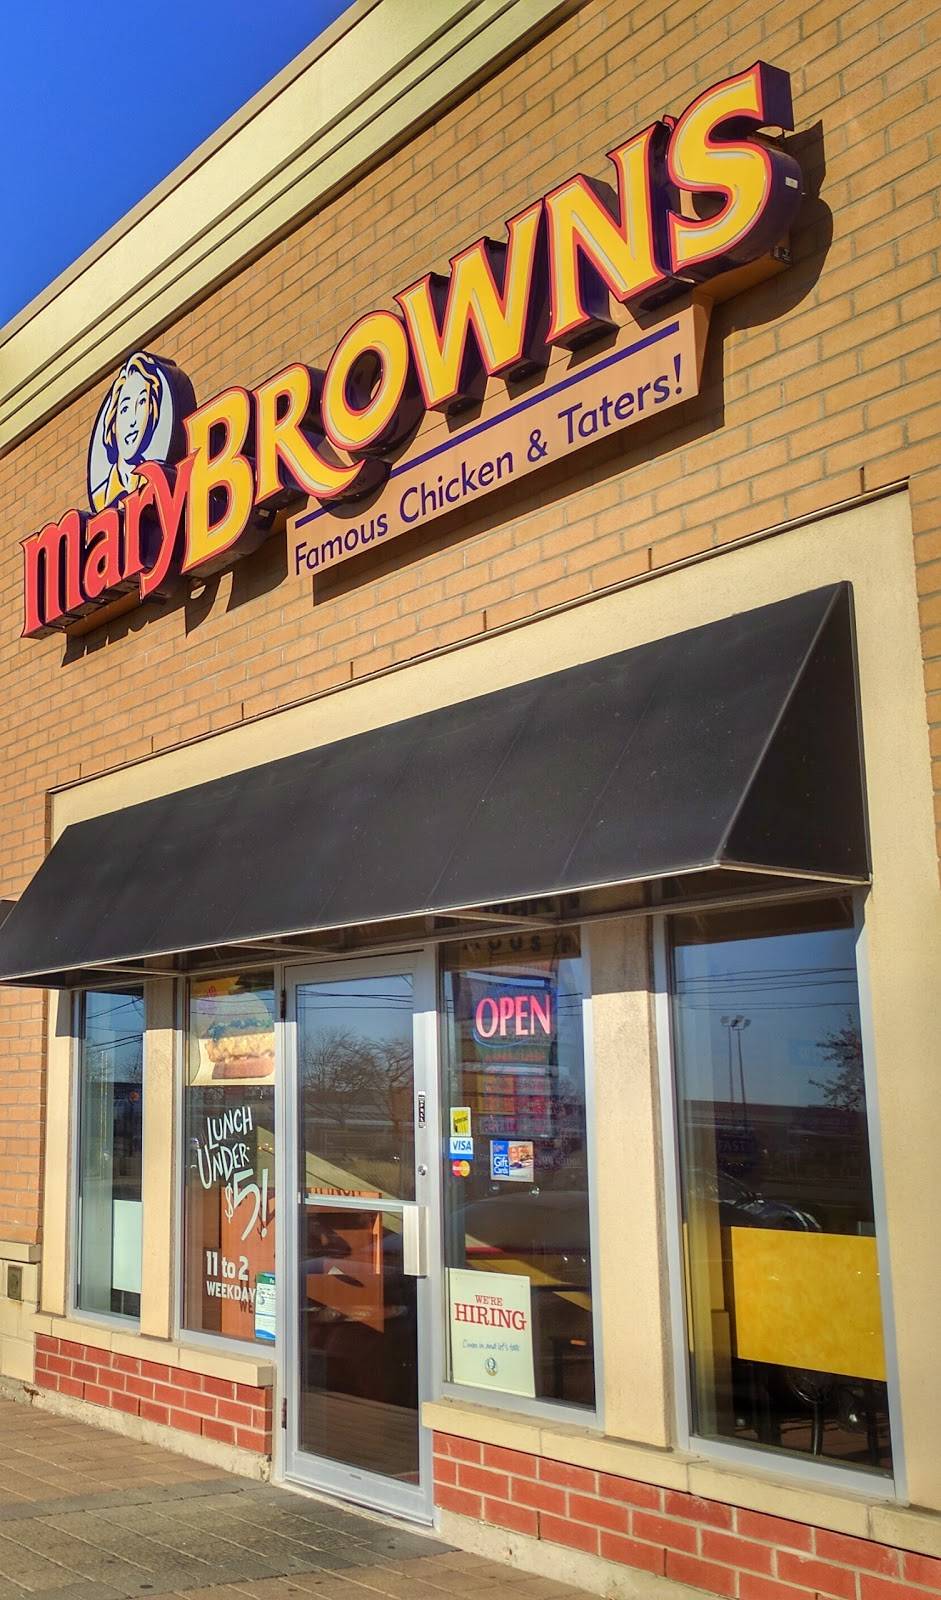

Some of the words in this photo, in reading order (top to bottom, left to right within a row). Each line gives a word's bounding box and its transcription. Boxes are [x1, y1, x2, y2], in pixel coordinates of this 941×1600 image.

[293, 511, 389, 576] Famous
[398, 451, 514, 524] Chicken
[527, 428, 548, 463] &
[556, 352, 684, 445] Taters!
[474, 993, 552, 1039] OPEN
[206, 1106, 253, 1150] LUNCH
[452, 1140, 472, 1151] VISA
[197, 1142, 250, 1190] UNDER
[224, 1168, 269, 1241] $5!
[206, 1250, 218, 1276] 11
[222, 1256, 236, 1279] to
[238, 1255, 249, 1281] 2
[453, 1302, 527, 1331] HIRING
[474, 1294, 503, 1307] WE'RE
